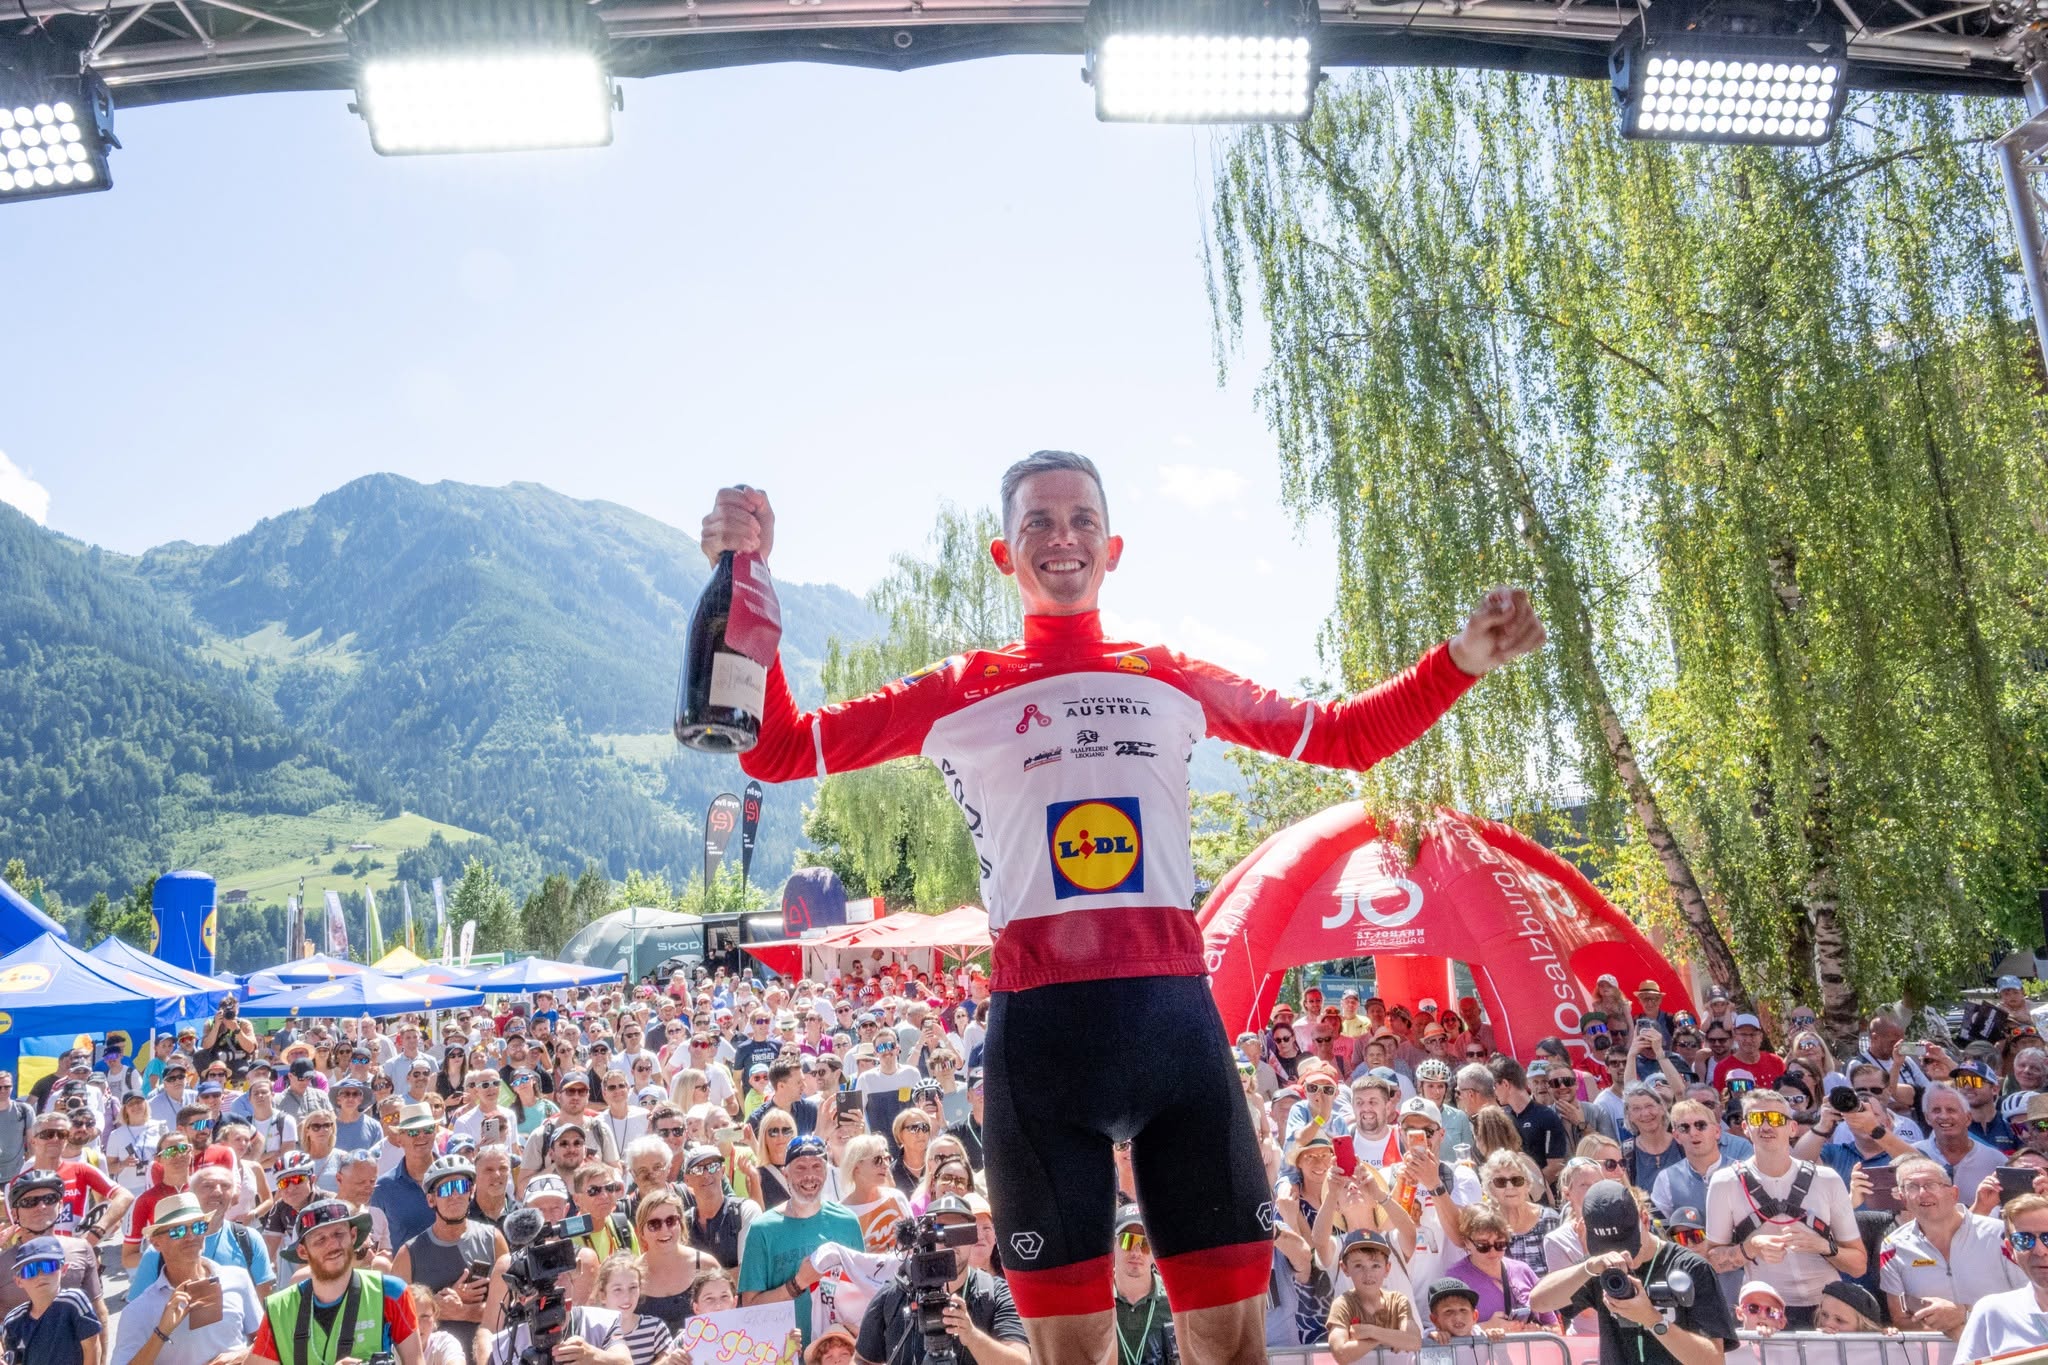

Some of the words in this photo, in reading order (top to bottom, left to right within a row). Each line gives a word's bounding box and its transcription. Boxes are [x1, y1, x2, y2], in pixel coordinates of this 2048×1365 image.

[1065, 704, 1152, 718] AUSTRIA
[1070, 745, 1109, 754] SAALFELDEN
[1321, 878, 1425, 929] JO
